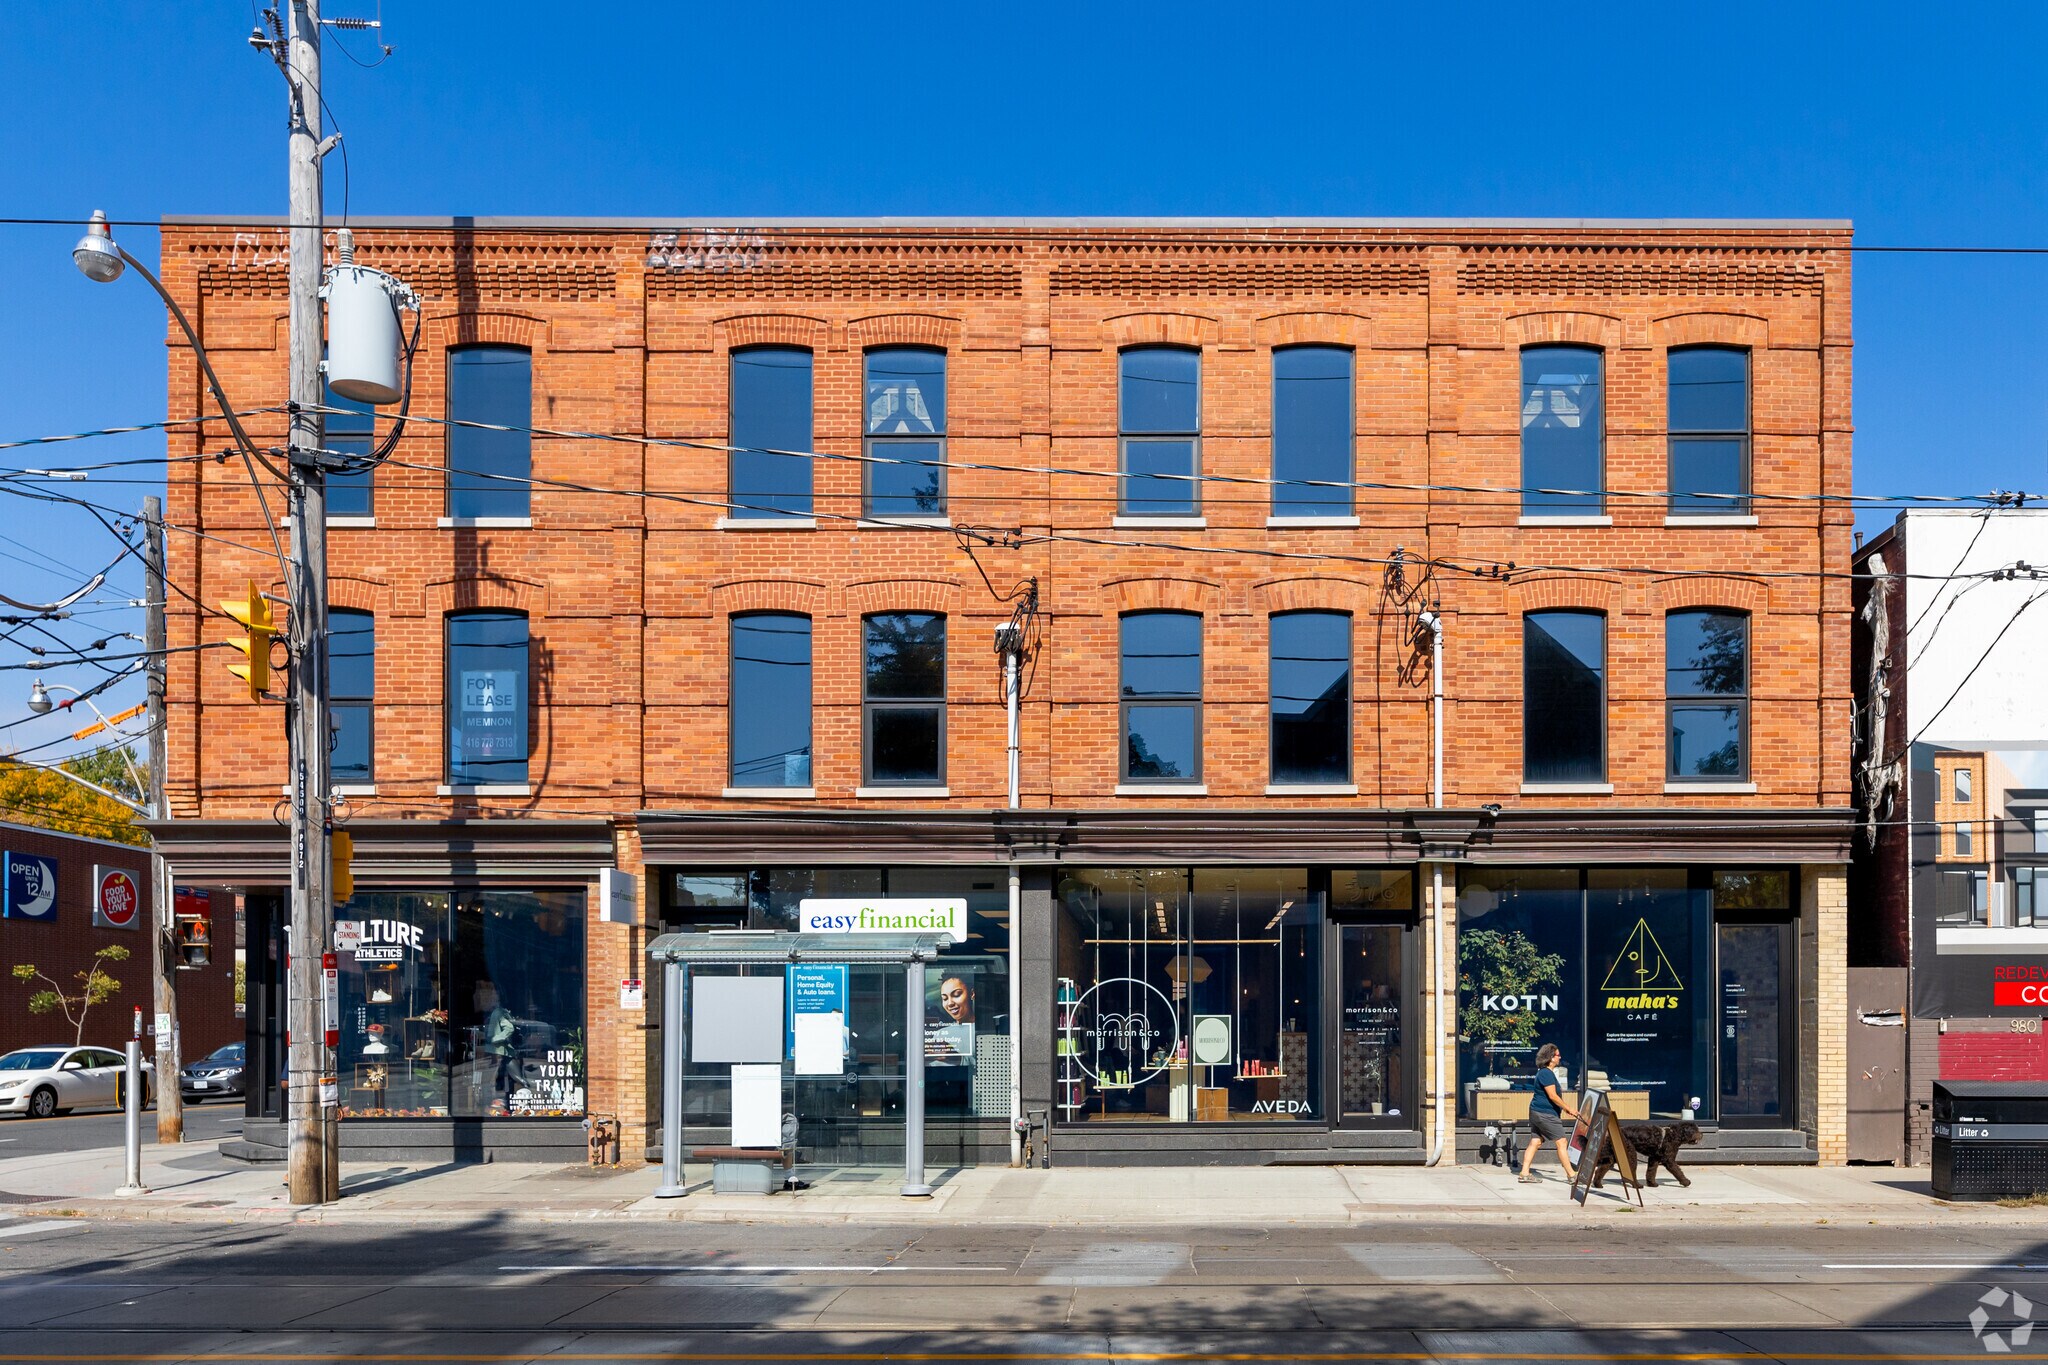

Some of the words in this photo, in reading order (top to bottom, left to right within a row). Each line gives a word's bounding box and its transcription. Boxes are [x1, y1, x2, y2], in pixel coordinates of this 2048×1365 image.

[467, 678, 496, 690] FOR
[467, 694, 512, 706] LEASE
[467, 717, 512, 727] MEMNON
[466, 737, 480, 748] 416
[495, 737, 513, 748] 7313
[10, 863, 40, 877] OPEN
[24, 875, 39, 883] UNTIL
[26, 882, 40, 896] 12
[40, 889, 51, 898] AM
[104, 885, 126, 898] FOOD
[105, 892, 132, 907] YOU'LL
[107, 903, 128, 915] LOVE
[344, 922, 353, 930] NO
[810, 907, 955, 933] easyfinancial
[338, 931, 360, 940] STANDING
[355, 948, 403, 958] ATHLETICS
[796, 981, 815, 989] Home
[815, 981, 835, 989] Equity
[1482, 994, 1559, 1011] KOTN
[1605, 993, 1679, 1009] maha's
[1626, 1013, 1658, 1021] CAFÉ
[2010, 1019, 2037, 1034] 980
[547, 1050, 578, 1063] RUN.
[540, 1065, 579, 1077] YOGA.
[1251, 1100, 1313, 1113] AVEDA
[1959, 1127, 1979, 1137] Litter
